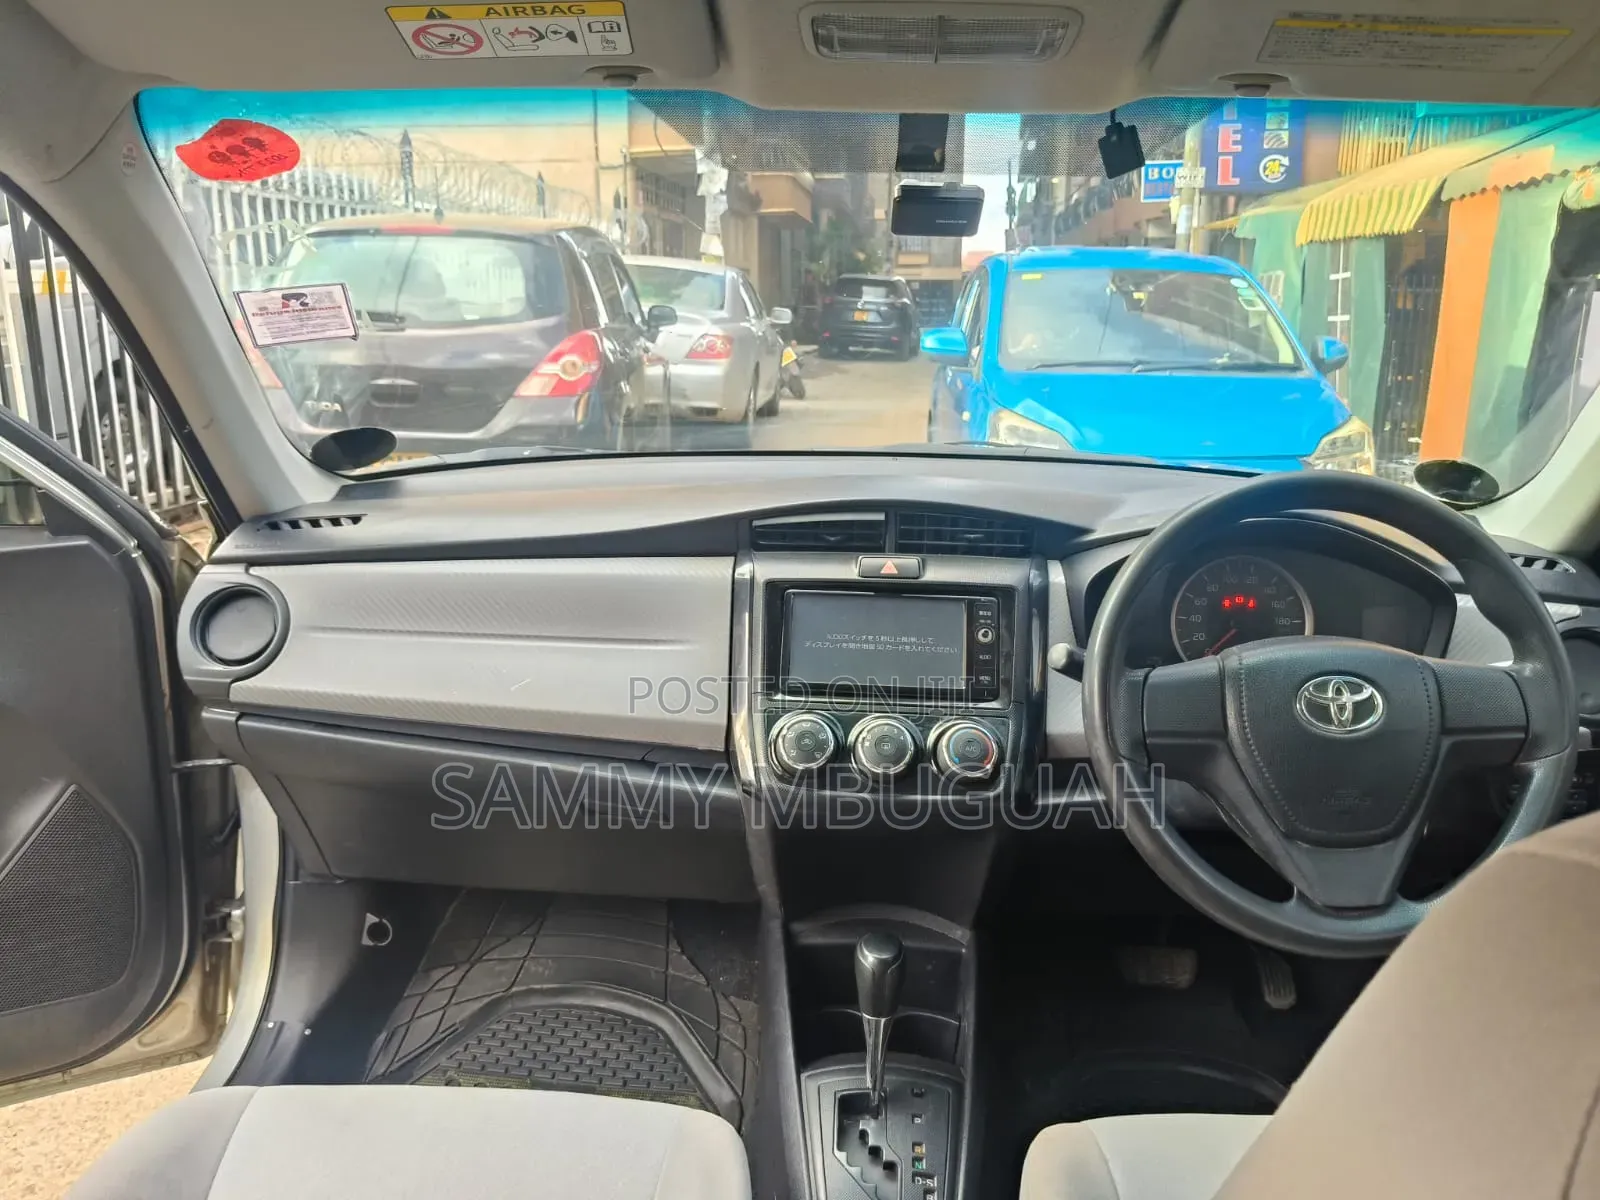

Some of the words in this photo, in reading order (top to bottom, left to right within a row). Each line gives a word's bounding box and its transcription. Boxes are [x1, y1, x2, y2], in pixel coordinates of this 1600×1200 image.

[485, 4, 587, 17] AIRBAG
[1271, 600, 1286, 609] 160
[1189, 614, 1202, 623] 40
[1275, 617, 1291, 626] 180
[1192, 632, 1205, 641] 20
[914, 1176, 934, 1187] D-S
